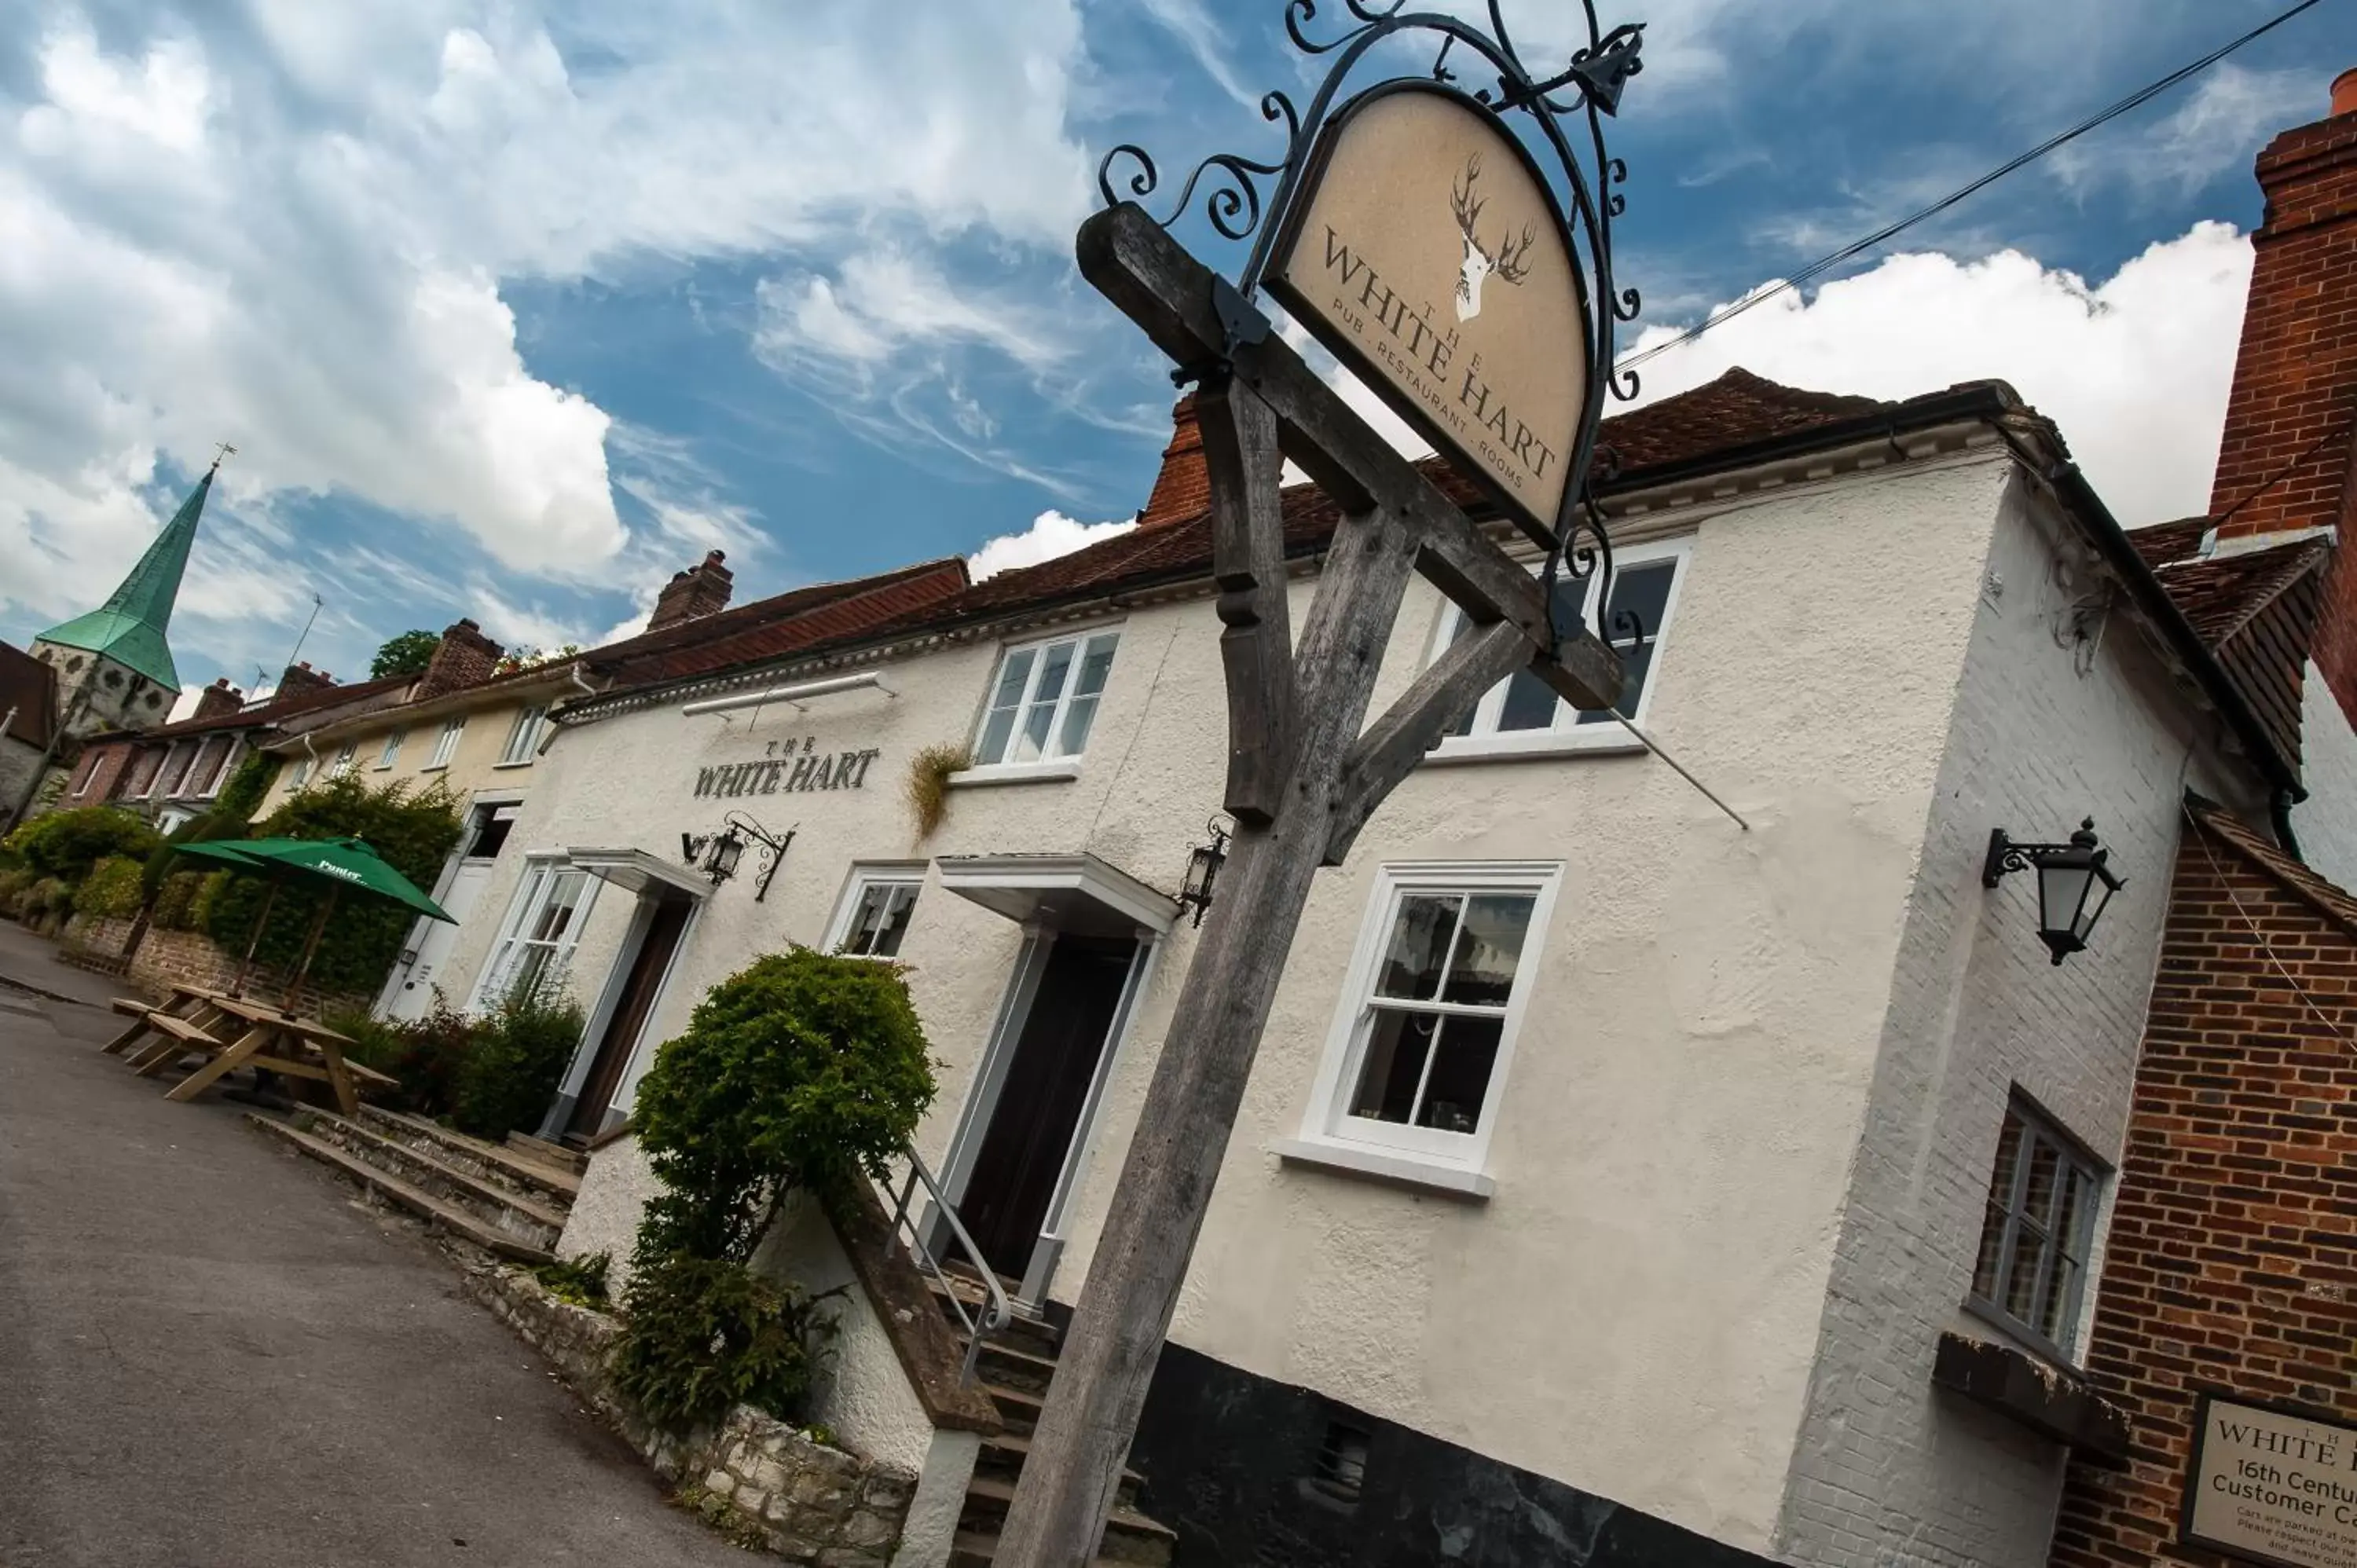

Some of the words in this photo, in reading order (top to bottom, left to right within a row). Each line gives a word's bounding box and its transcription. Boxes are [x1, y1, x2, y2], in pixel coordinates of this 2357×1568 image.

[1325, 224, 1452, 383] WHITE
[1458, 368, 1556, 480] HART
[1424, 301, 1482, 371] THE
[1332, 298, 1364, 334] PUB
[1376, 340, 1467, 433] RESTAURANT
[1478, 441, 1523, 489] ROOMS
[766, 735, 816, 757] THE
[693, 759, 786, 800] WHITE
[783, 747, 880, 793] HART
[2218, 1420, 2337, 1466] WHITE
[2304, 1427, 2357, 1449] TH
[2212, 1475, 2326, 1517] Customer
[2237, 1459, 2281, 1485] 16th
[2287, 1471, 2357, 1504] Centu
